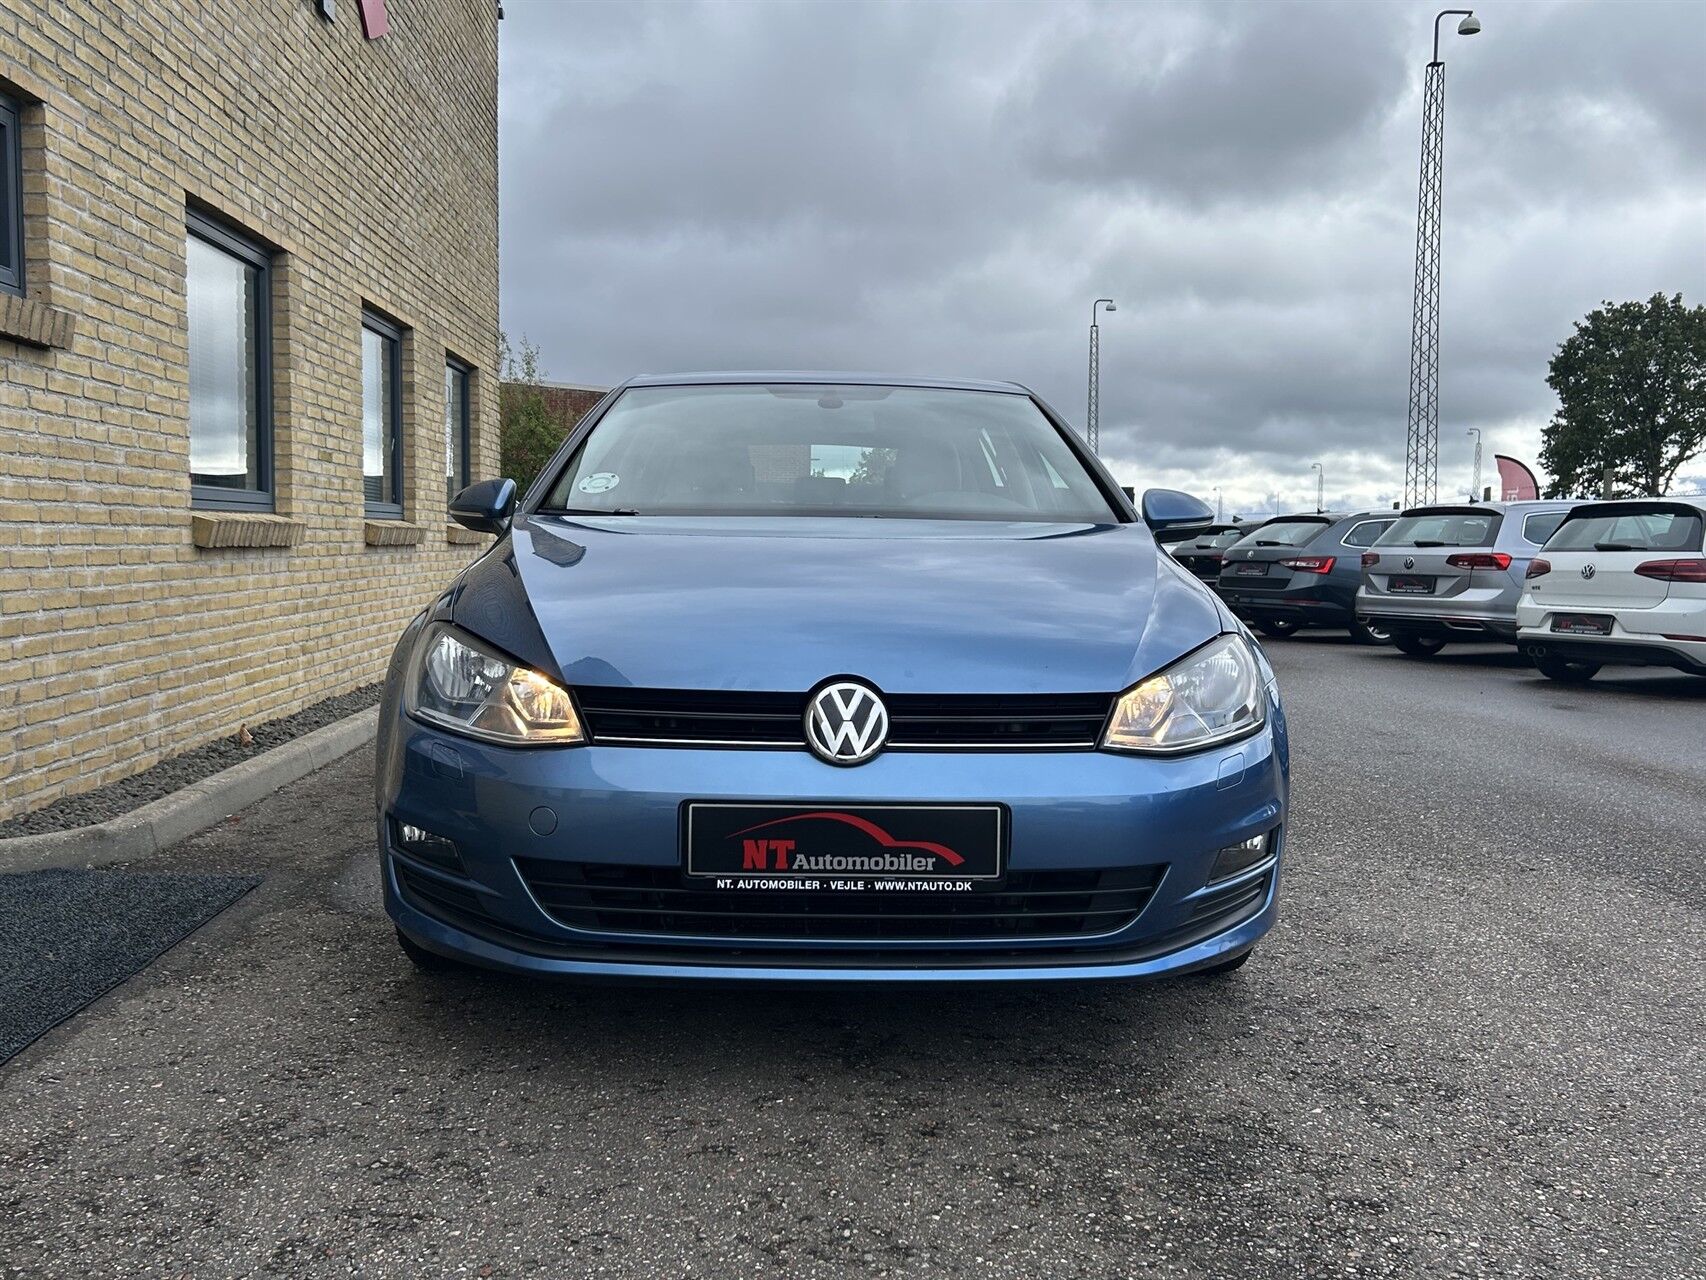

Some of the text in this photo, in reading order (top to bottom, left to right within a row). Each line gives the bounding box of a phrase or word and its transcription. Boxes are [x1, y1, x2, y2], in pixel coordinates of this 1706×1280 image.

[805, 683, 888, 763] VW
[742, 839, 936, 870] NT Automobiler
[716, 879, 972, 891] NT. AUTOMOBILER VEJLE WWW.NTAUTO.DK
